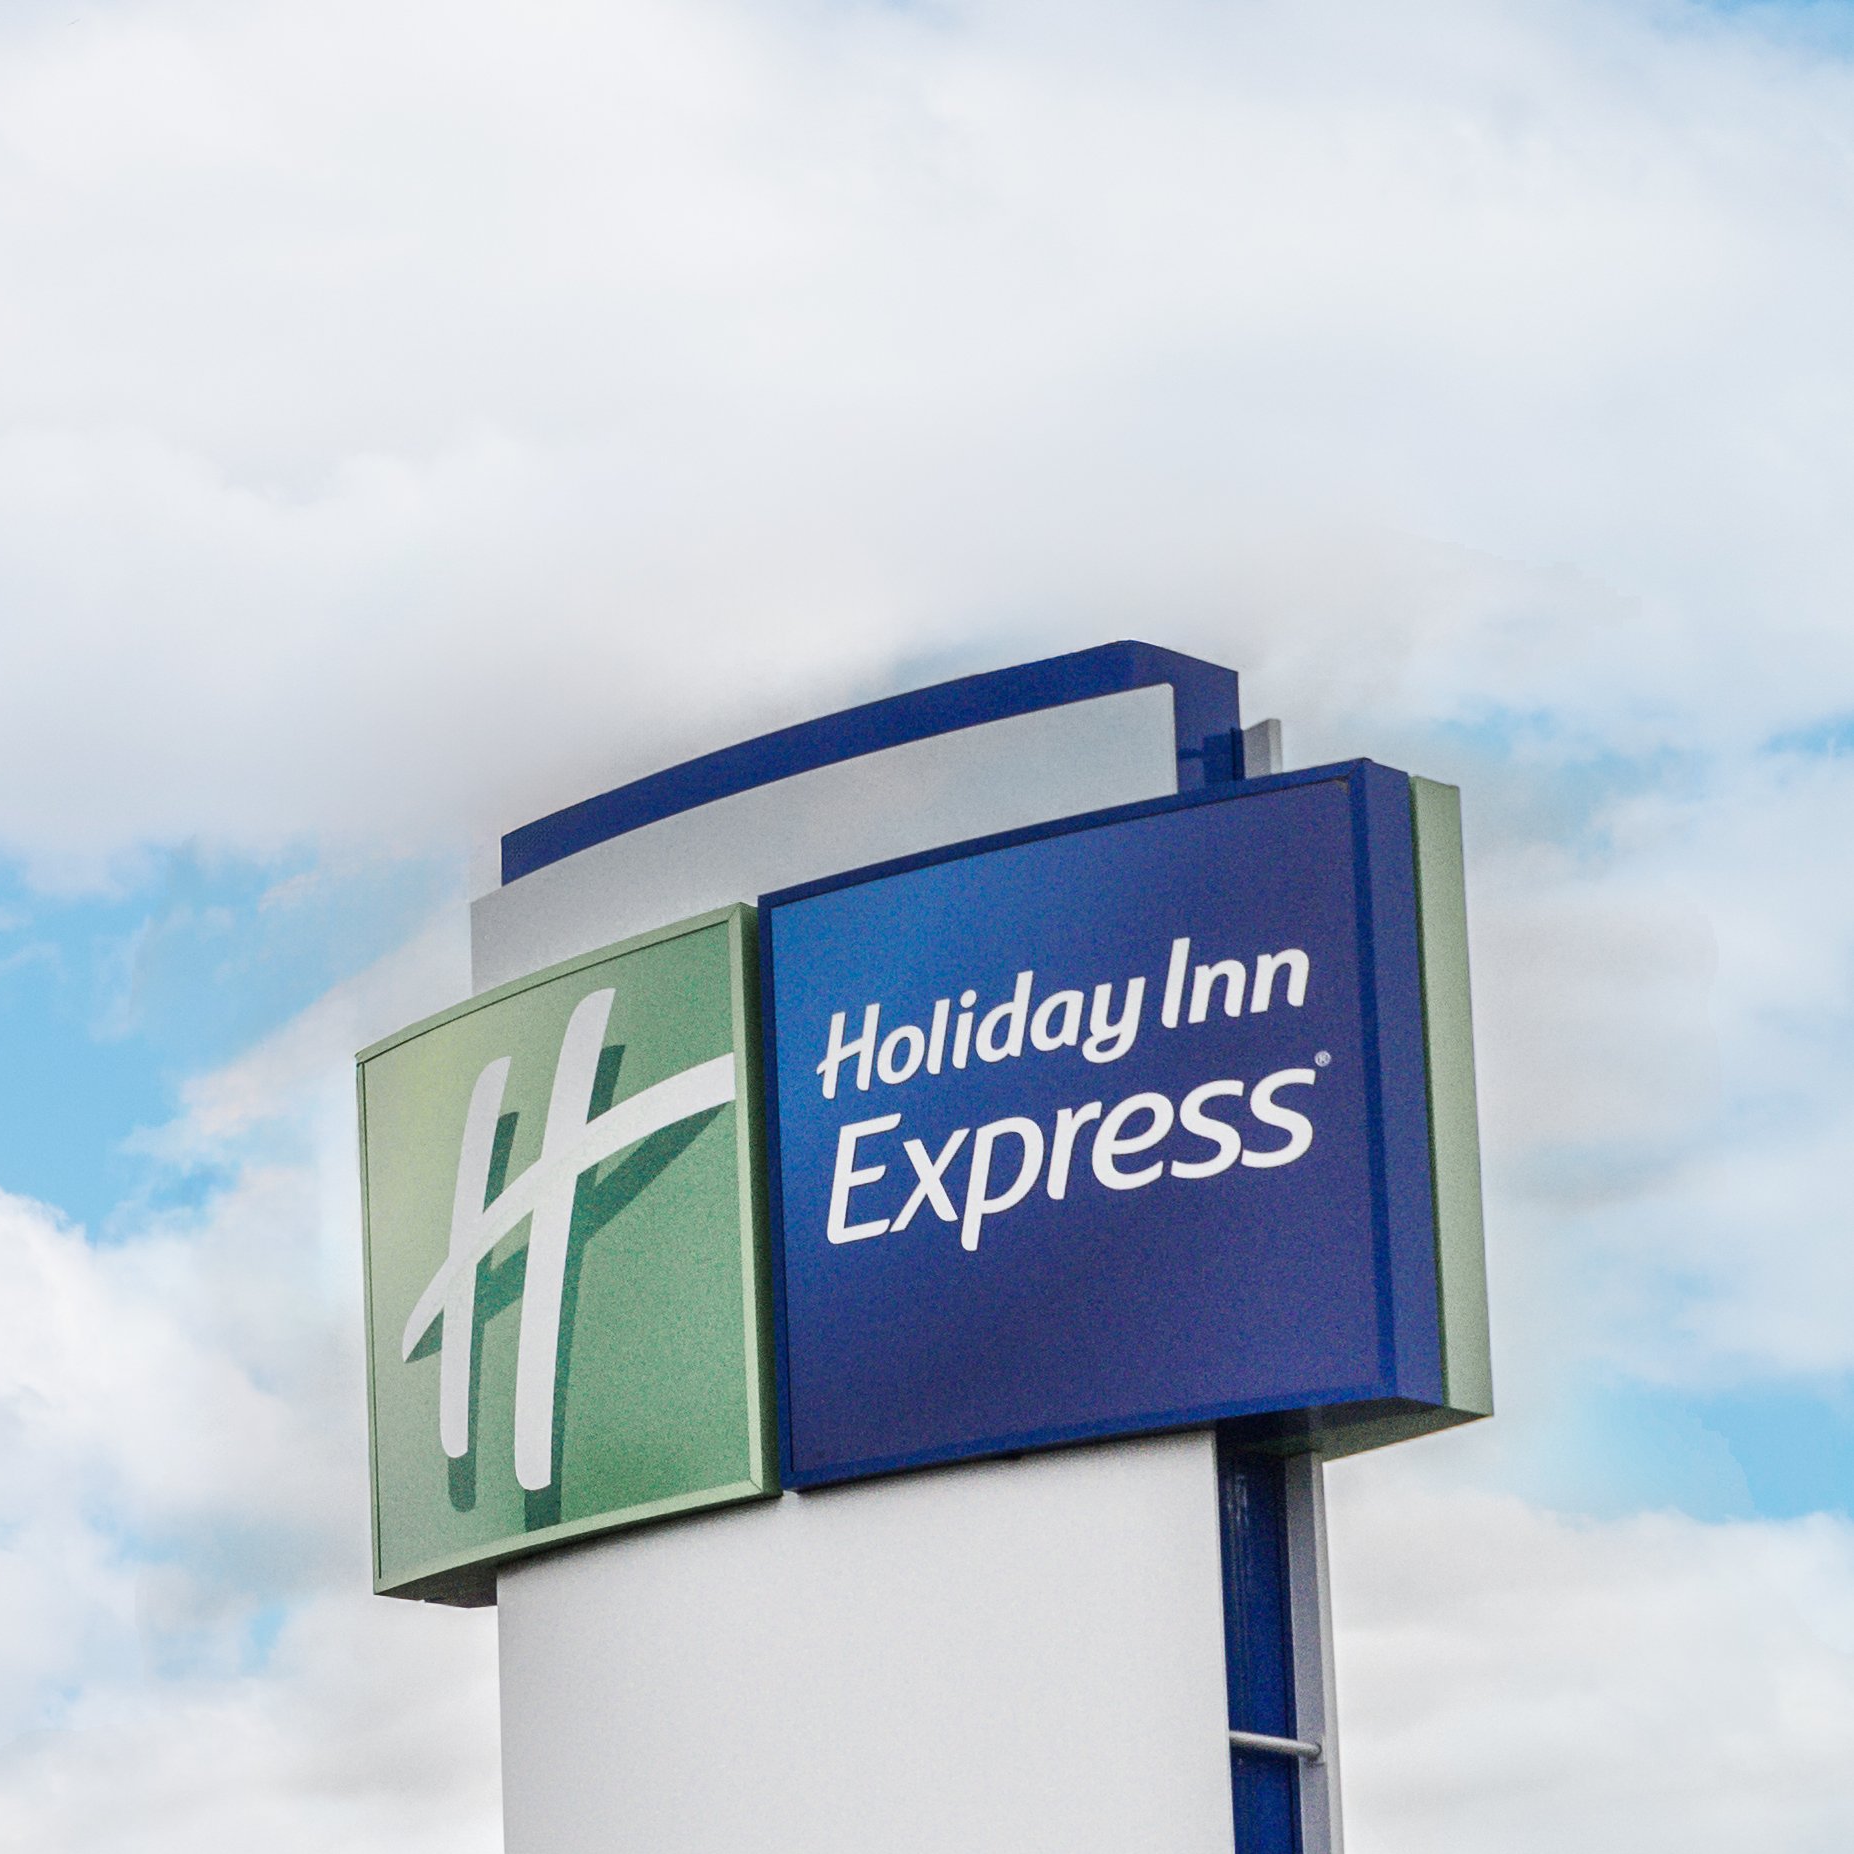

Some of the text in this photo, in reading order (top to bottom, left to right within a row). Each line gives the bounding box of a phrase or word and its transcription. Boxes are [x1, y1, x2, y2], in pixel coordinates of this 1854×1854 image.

[817, 938, 1310, 1099] Holiday Inn
[827, 1068, 1316, 1251] Express
